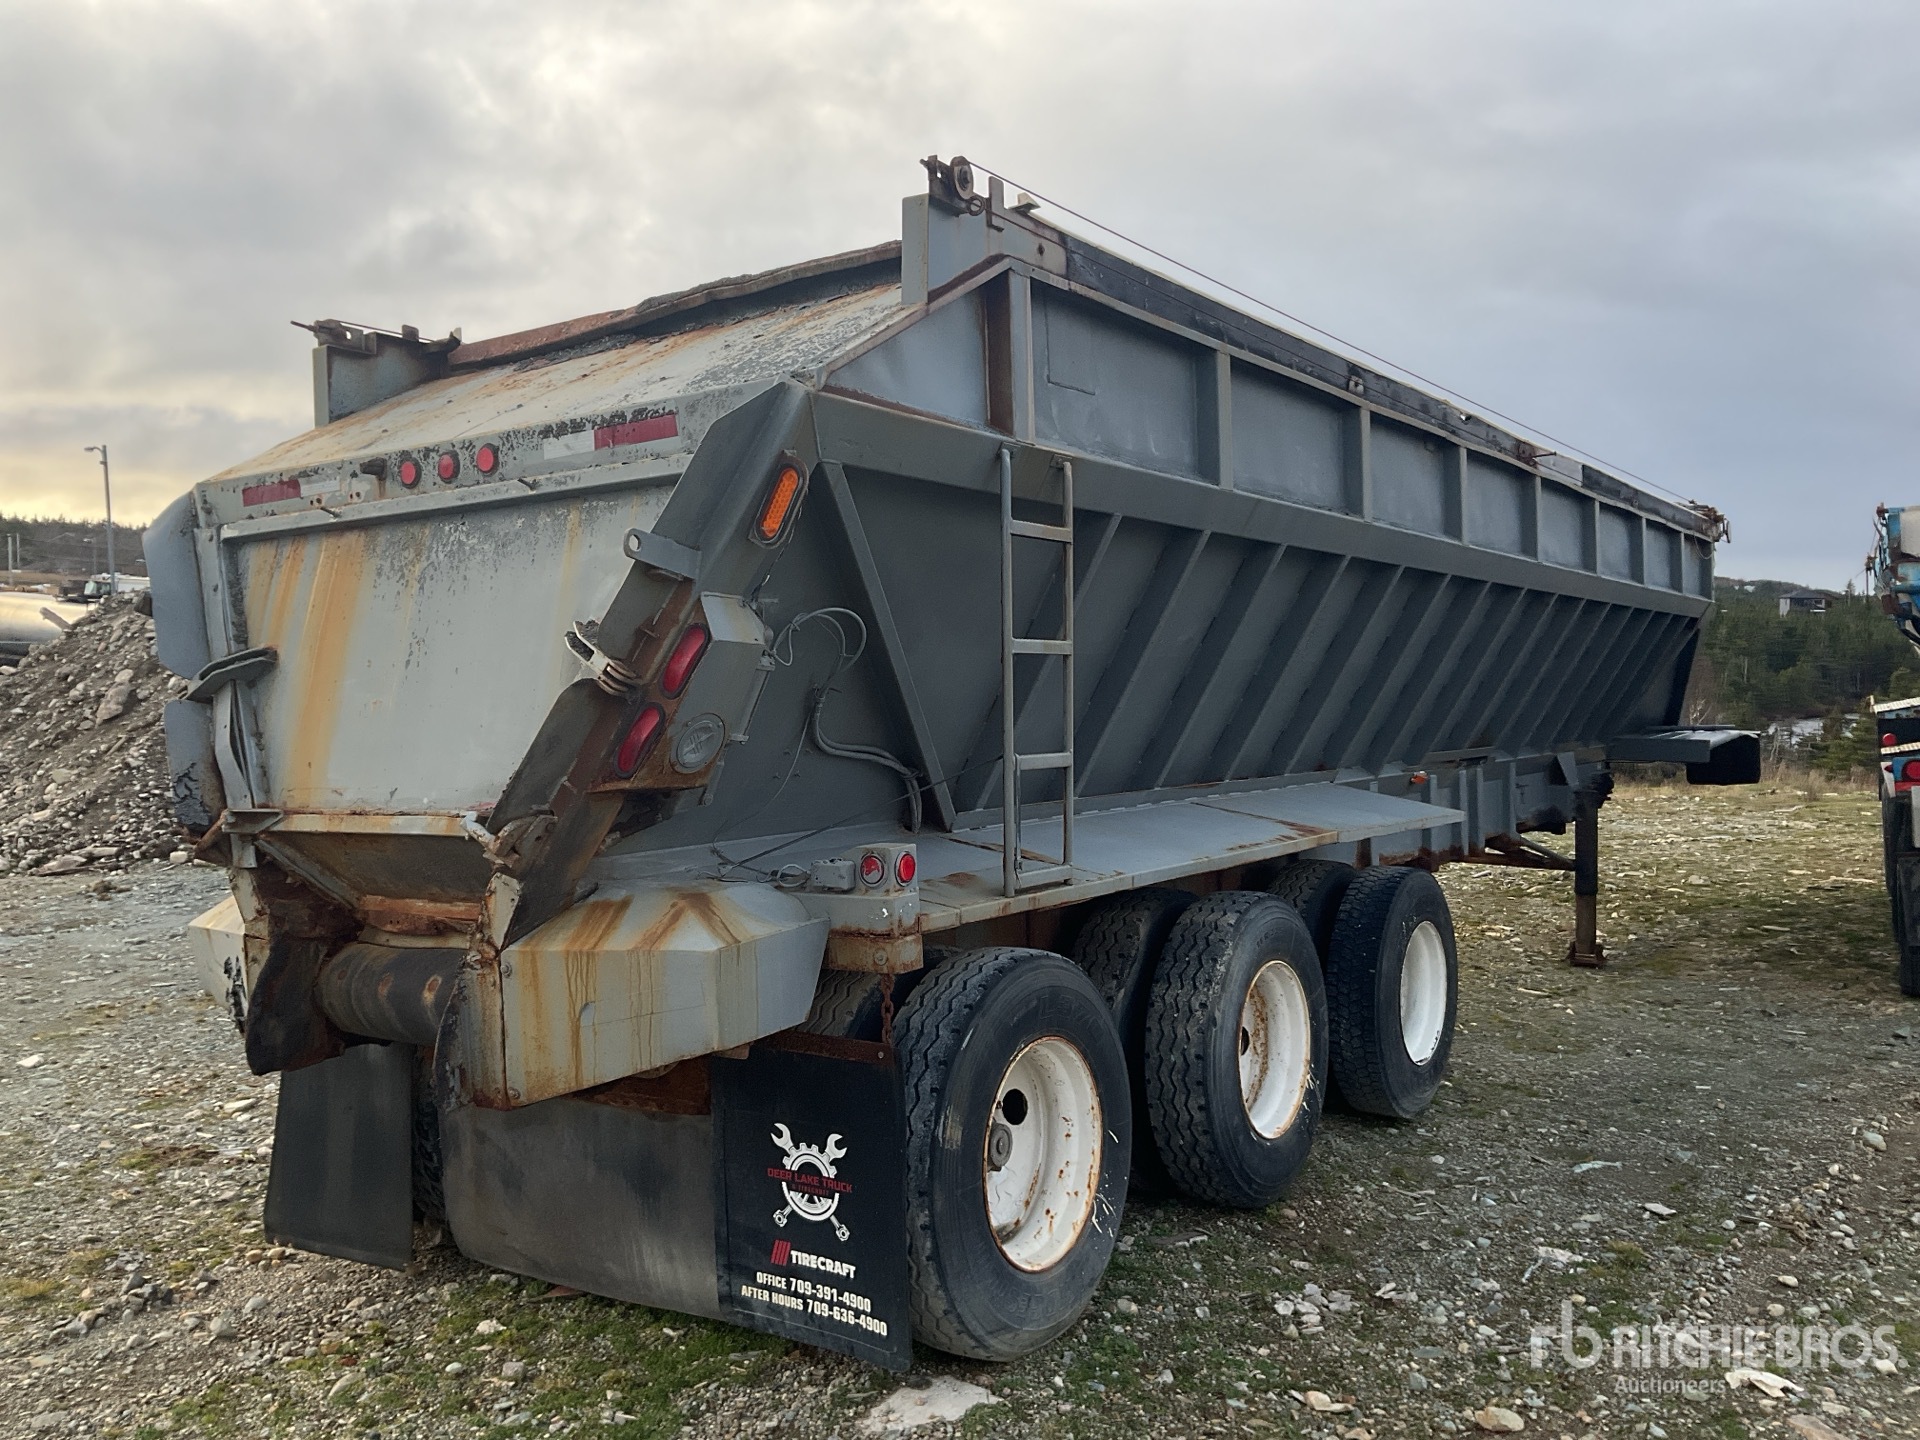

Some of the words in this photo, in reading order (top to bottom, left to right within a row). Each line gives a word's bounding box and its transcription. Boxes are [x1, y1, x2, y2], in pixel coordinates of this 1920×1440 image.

[767, 1168, 792, 1181] DEER
[795, 1172, 820, 1186] LAKE
[821, 1178, 853, 1193] TRUCK
[790, 1250, 856, 1279] TIRECRAFT
[756, 1271, 787, 1290] OFFICE
[789, 1277, 872, 1313] 709-391-4900
[741, 1285, 770, 1302] AFTER
[771, 1291, 804, 1311] HOURS
[806, 1299, 888, 1337] 709-636-4900
